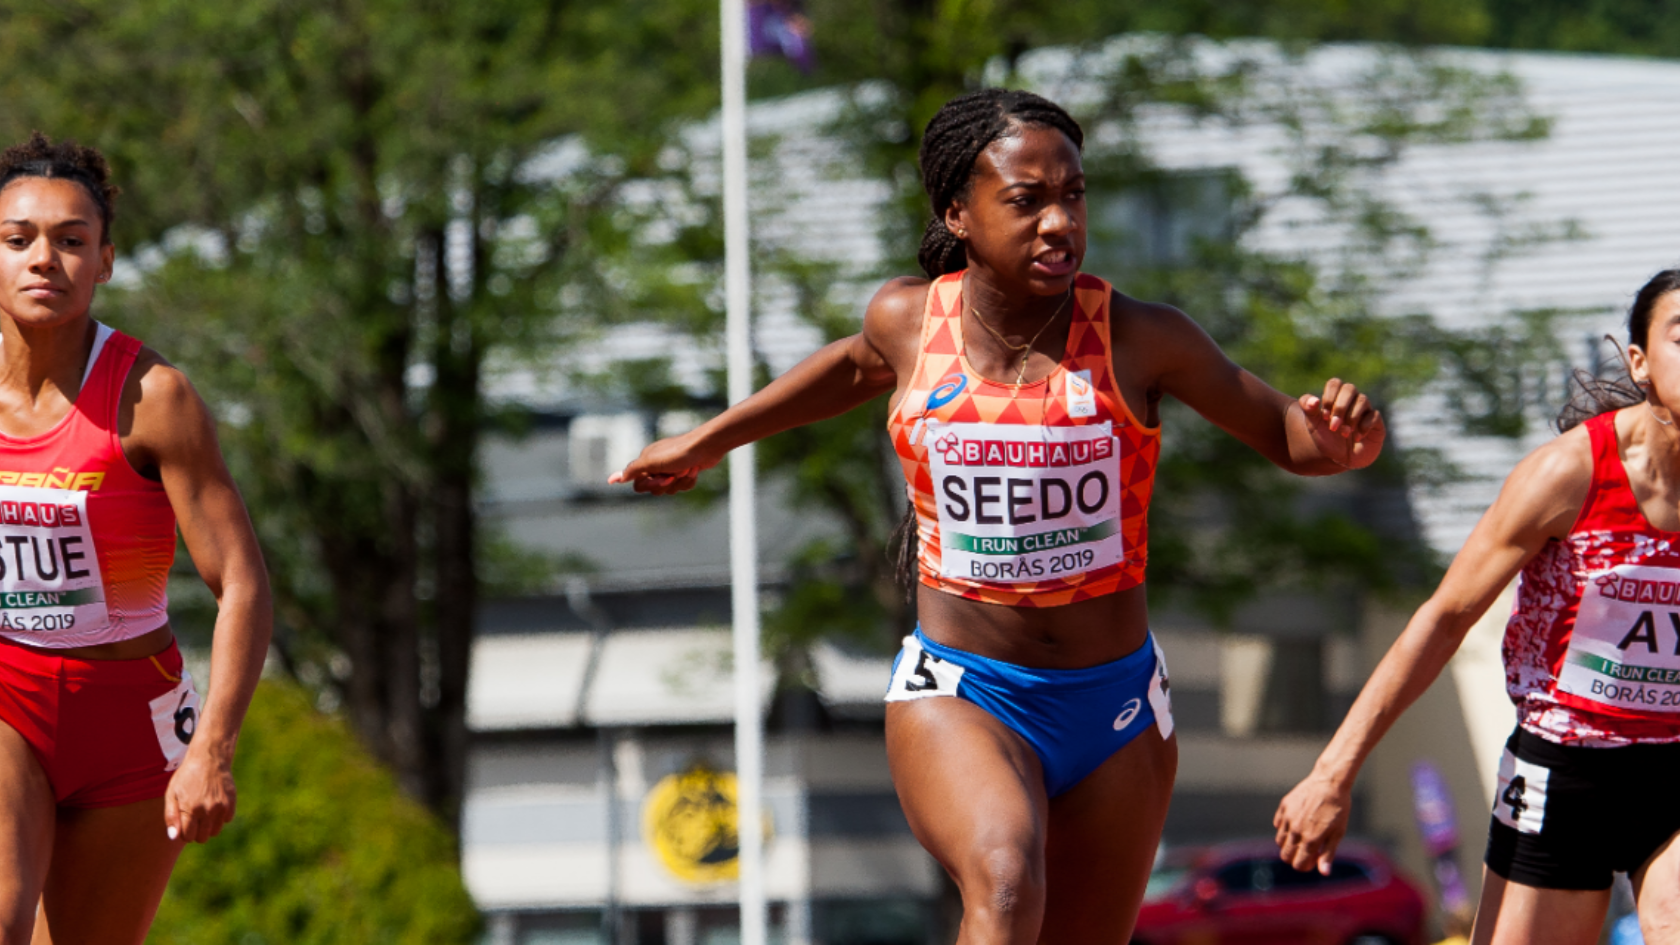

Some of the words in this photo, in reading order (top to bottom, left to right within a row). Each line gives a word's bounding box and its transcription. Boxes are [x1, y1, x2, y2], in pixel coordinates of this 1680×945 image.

[965, 439, 1110, 464] BAUHAUS
[942, 470, 1109, 525] SEEDO
[3, 504, 77, 524] HAUS
[0, 535, 90, 581] TUE
[973, 538, 978, 551] I
[981, 538, 1018, 552] RUN
[970, 556, 1044, 578] BORÅS
[1049, 549, 1095, 574] 2019
[1621, 581, 1680, 602] BAU
[31, 613, 76, 632] 2019
[904, 650, 941, 692] 5
[1601, 659, 1608, 673] I
[1609, 664, 1643, 680] RUN
[1590, 679, 1658, 705] BORÅS
[173, 689, 196, 746] 6
[1502, 774, 1529, 822] 4
